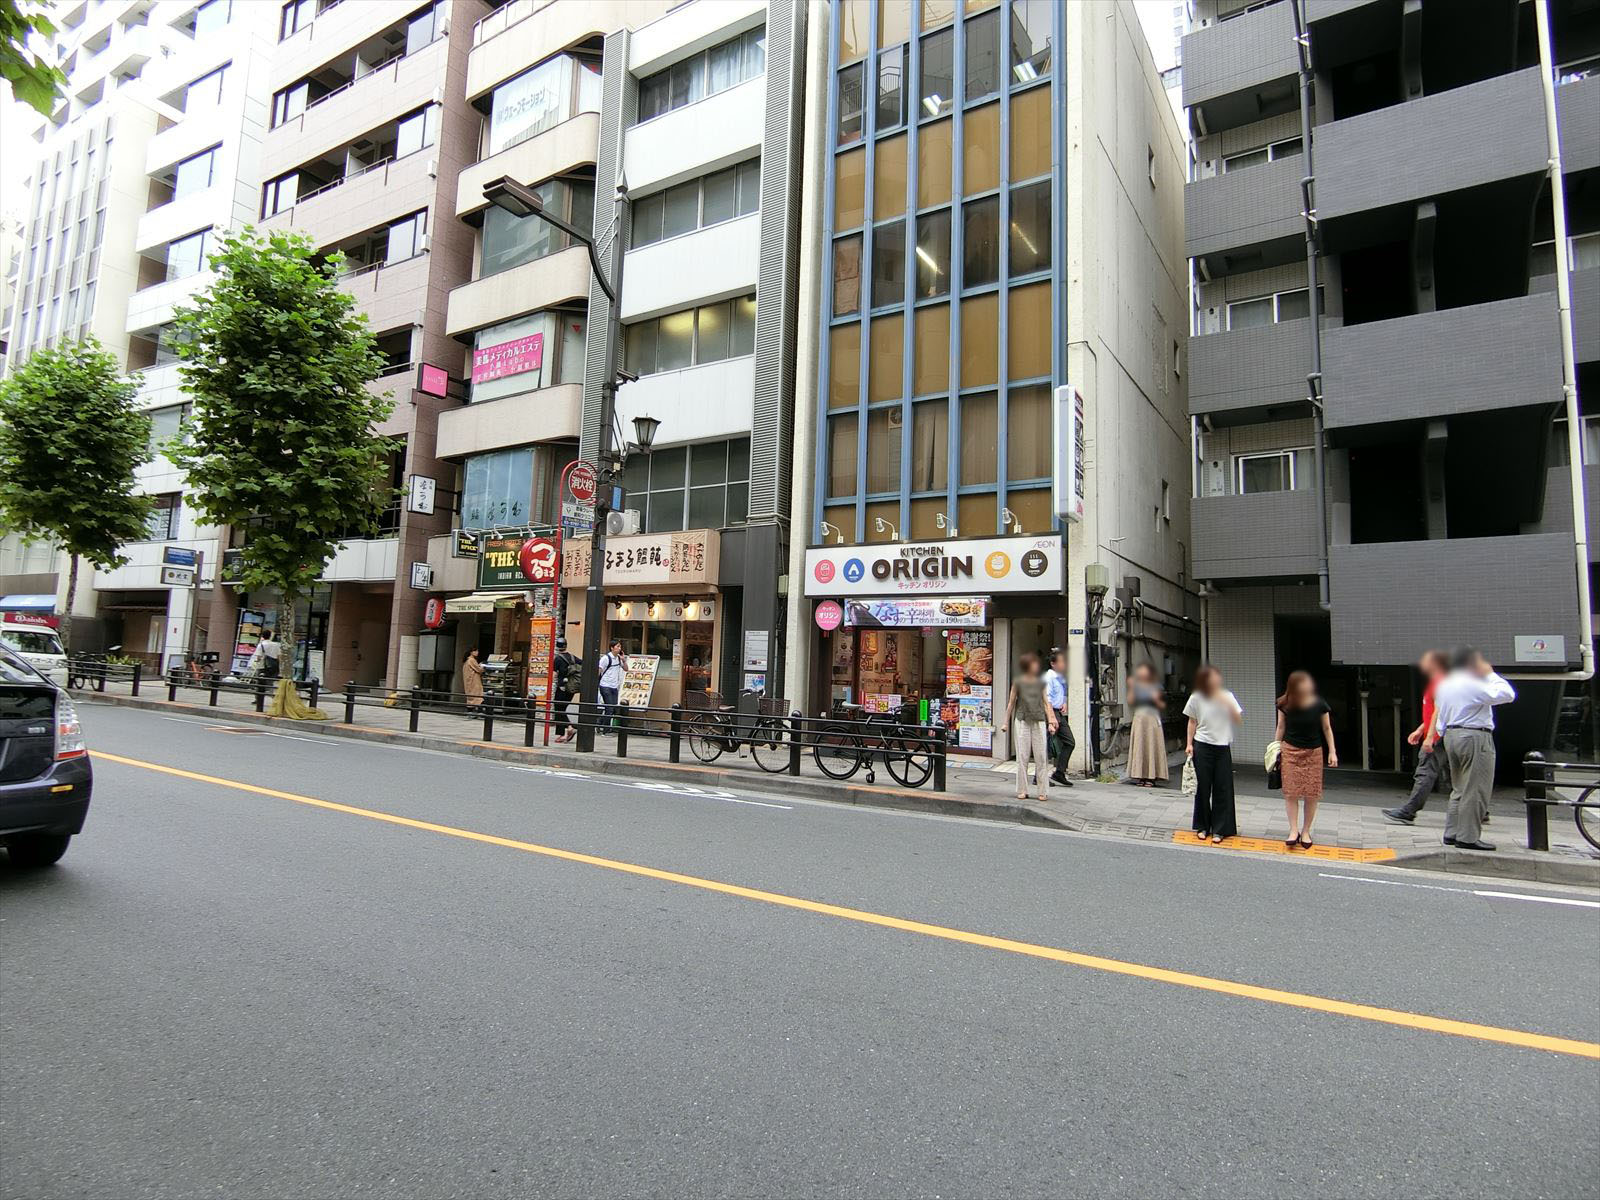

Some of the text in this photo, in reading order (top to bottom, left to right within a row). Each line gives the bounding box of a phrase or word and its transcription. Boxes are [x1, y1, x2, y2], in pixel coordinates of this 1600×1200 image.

[572, 475, 593, 492] 消火栓
[605, 546, 662, 570] るまる饂飩
[900, 546, 944, 557] KITCHEN
[872, 556, 973, 579] ORIGIN
